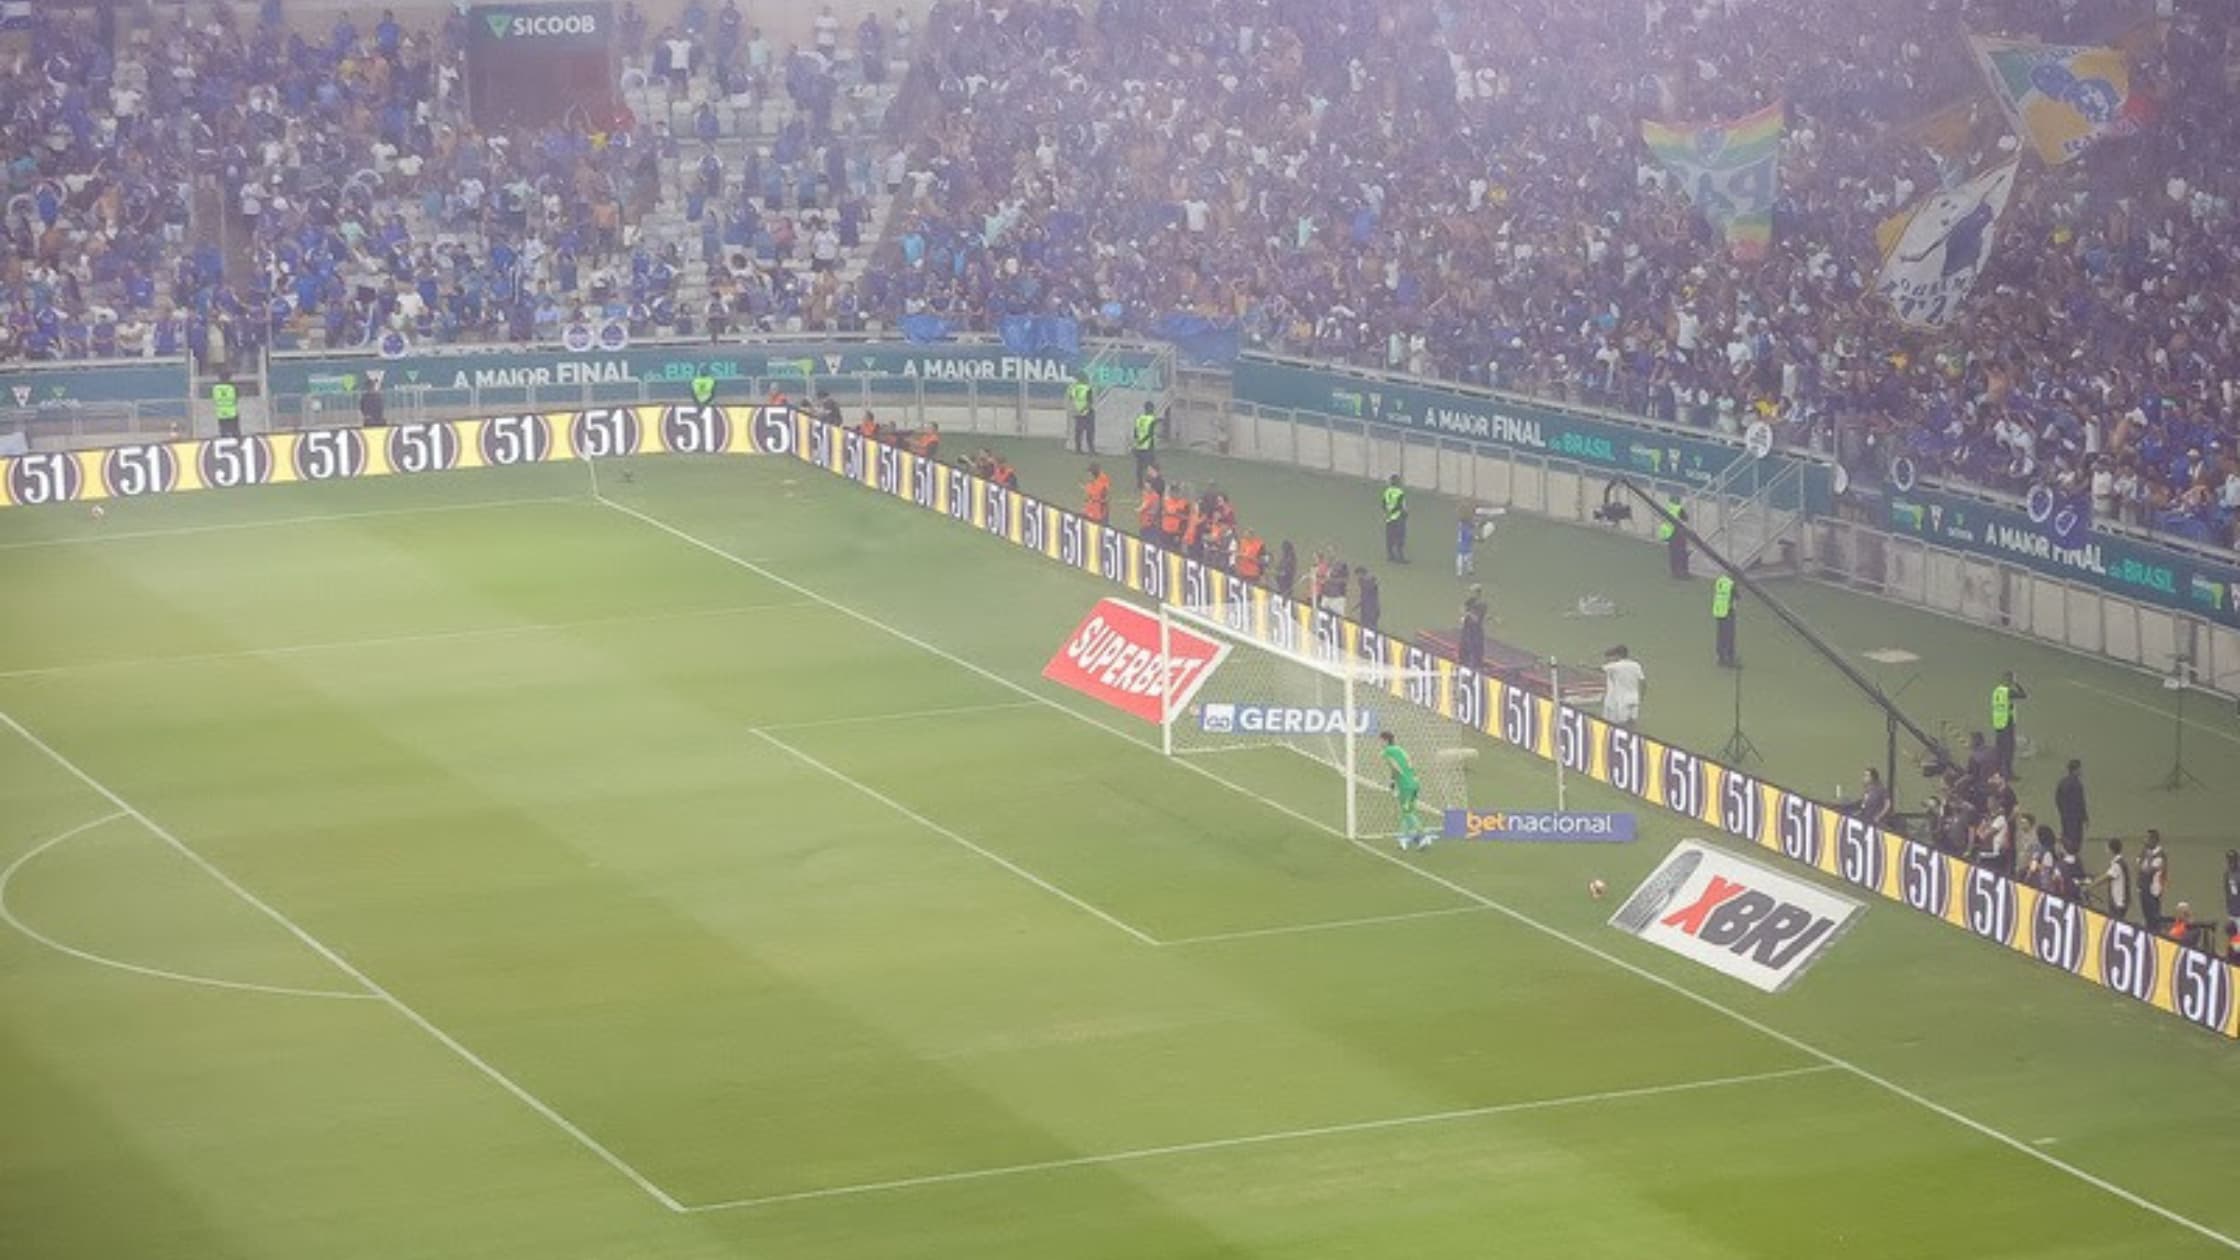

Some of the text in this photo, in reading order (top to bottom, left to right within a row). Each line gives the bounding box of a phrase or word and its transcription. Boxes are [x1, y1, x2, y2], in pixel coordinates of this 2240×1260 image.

[513, 15, 596, 36] SICOOB
[453, 370, 470, 389] A
[475, 367, 550, 388] MAIOR
[557, 360, 639, 383] FINAL
[904, 359, 918, 378] A
[923, 359, 995, 381] MAIOR
[1002, 357, 1077, 382] FINAL
[23, 454, 66, 503] 51
[119, 445, 158, 495] 51
[214, 437, 256, 486] 51
[308, 430, 352, 478] 51
[402, 423, 442, 472] 51
[495, 414, 535, 464] 51
[585, 408, 625, 456] 51
[675, 406, 715, 453] 51
[1424, 406, 1437, 428] A
[1439, 409, 1489, 438] MAIOR
[1492, 415, 1546, 448] FINAL
[1562, 431, 1616, 461] BRASIL
[1985, 522, 1997, 546] A
[2001, 526, 2050, 559] MAIOR
[2052, 543, 2106, 575] FINAL
[2122, 558, 2176, 594] BRASIL
[1067, 616, 1205, 696] SUPERBET
[812, 422, 2218, 1029] 51 51 51 51 51 51 51 51 51 51 51 51 51 51 51 51 51 51 51 51 51 51 51 51 51 51 51 51 51
[1239, 707, 1370, 733] GERDAU
[1466, 811, 1612, 837] betnacional
[1661, 875, 1837, 971] XBRI
